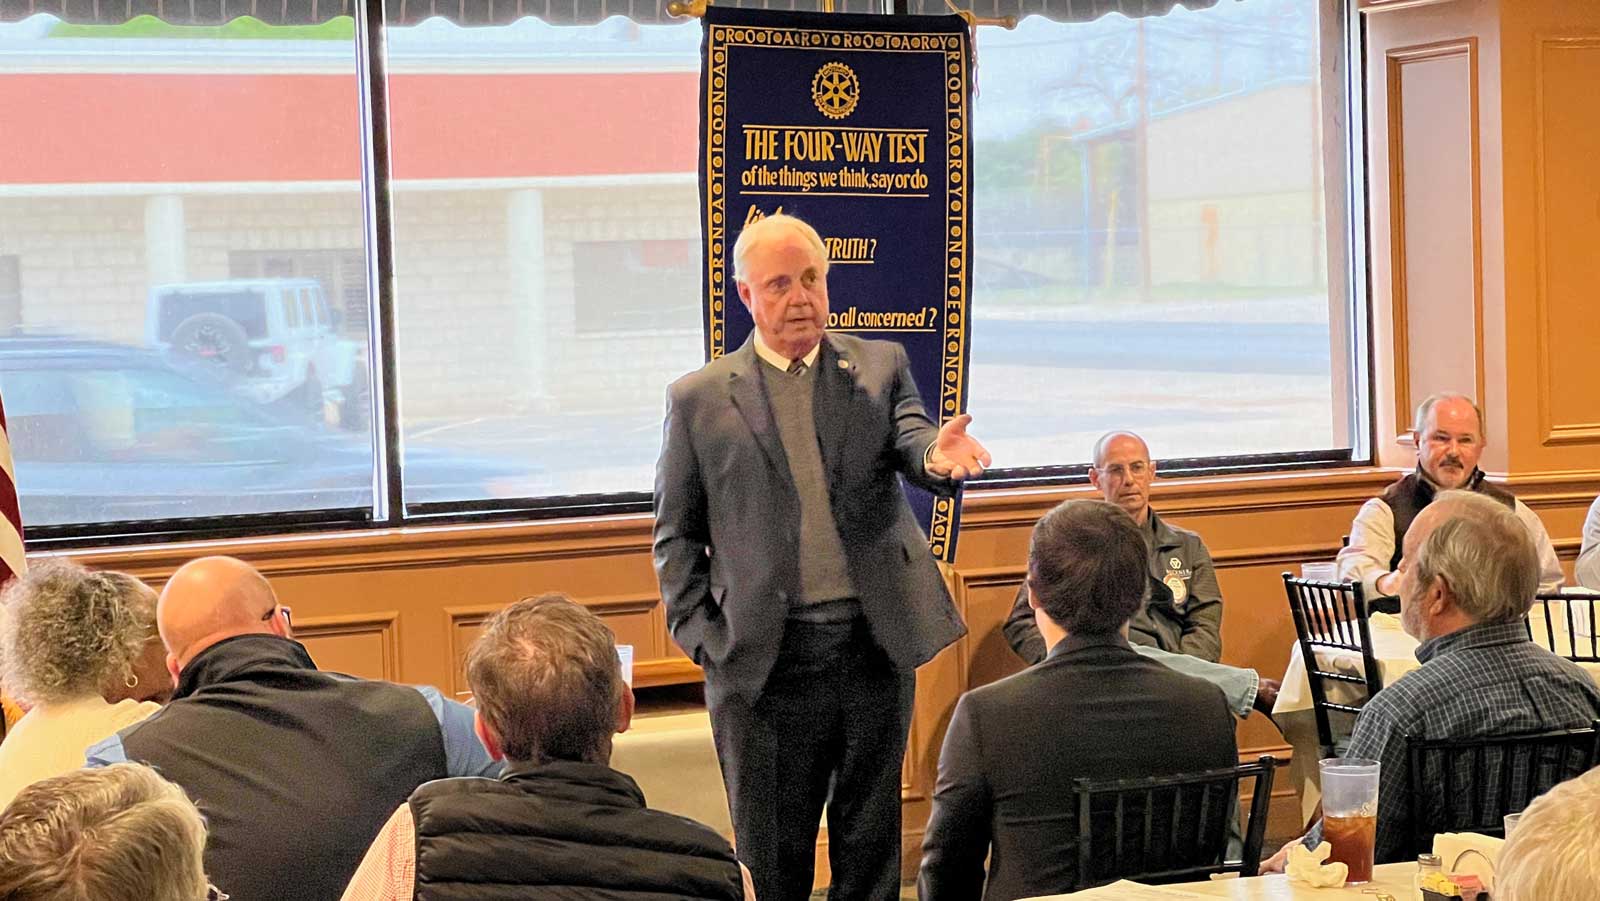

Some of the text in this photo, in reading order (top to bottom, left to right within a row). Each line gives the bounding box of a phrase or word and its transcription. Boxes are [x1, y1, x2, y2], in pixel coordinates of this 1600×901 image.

[743, 129, 928, 164] THE FOUR-WAY TEST
[741, 164, 929, 193] of the things we think, say or do
[711, 46, 726, 360] NTERNATIONAL
[824, 312, 839, 328] o
[839, 307, 857, 328] all
